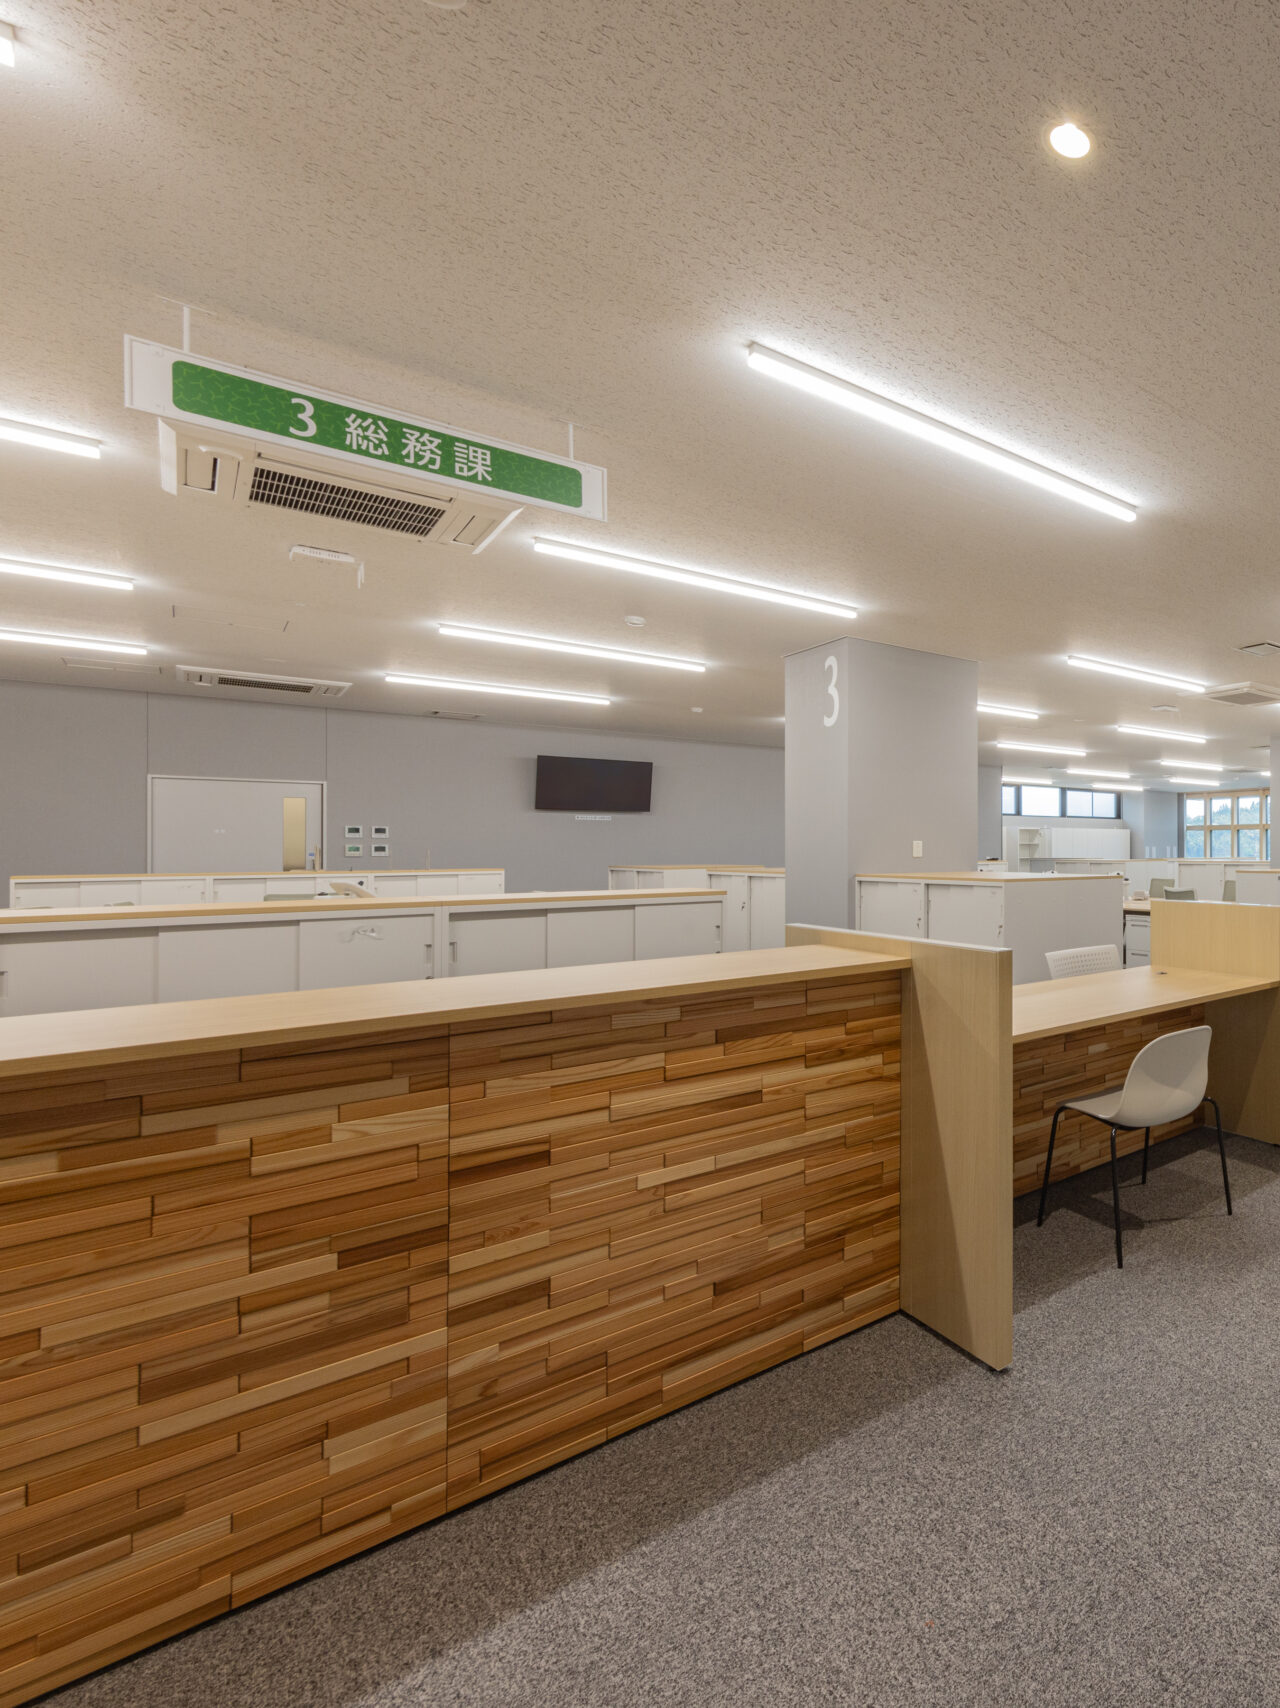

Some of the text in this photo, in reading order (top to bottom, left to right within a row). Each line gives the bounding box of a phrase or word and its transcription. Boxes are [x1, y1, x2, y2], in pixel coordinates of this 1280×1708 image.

[289, 397, 493, 482] 3 総務課
[823, 655, 840, 728] 3
